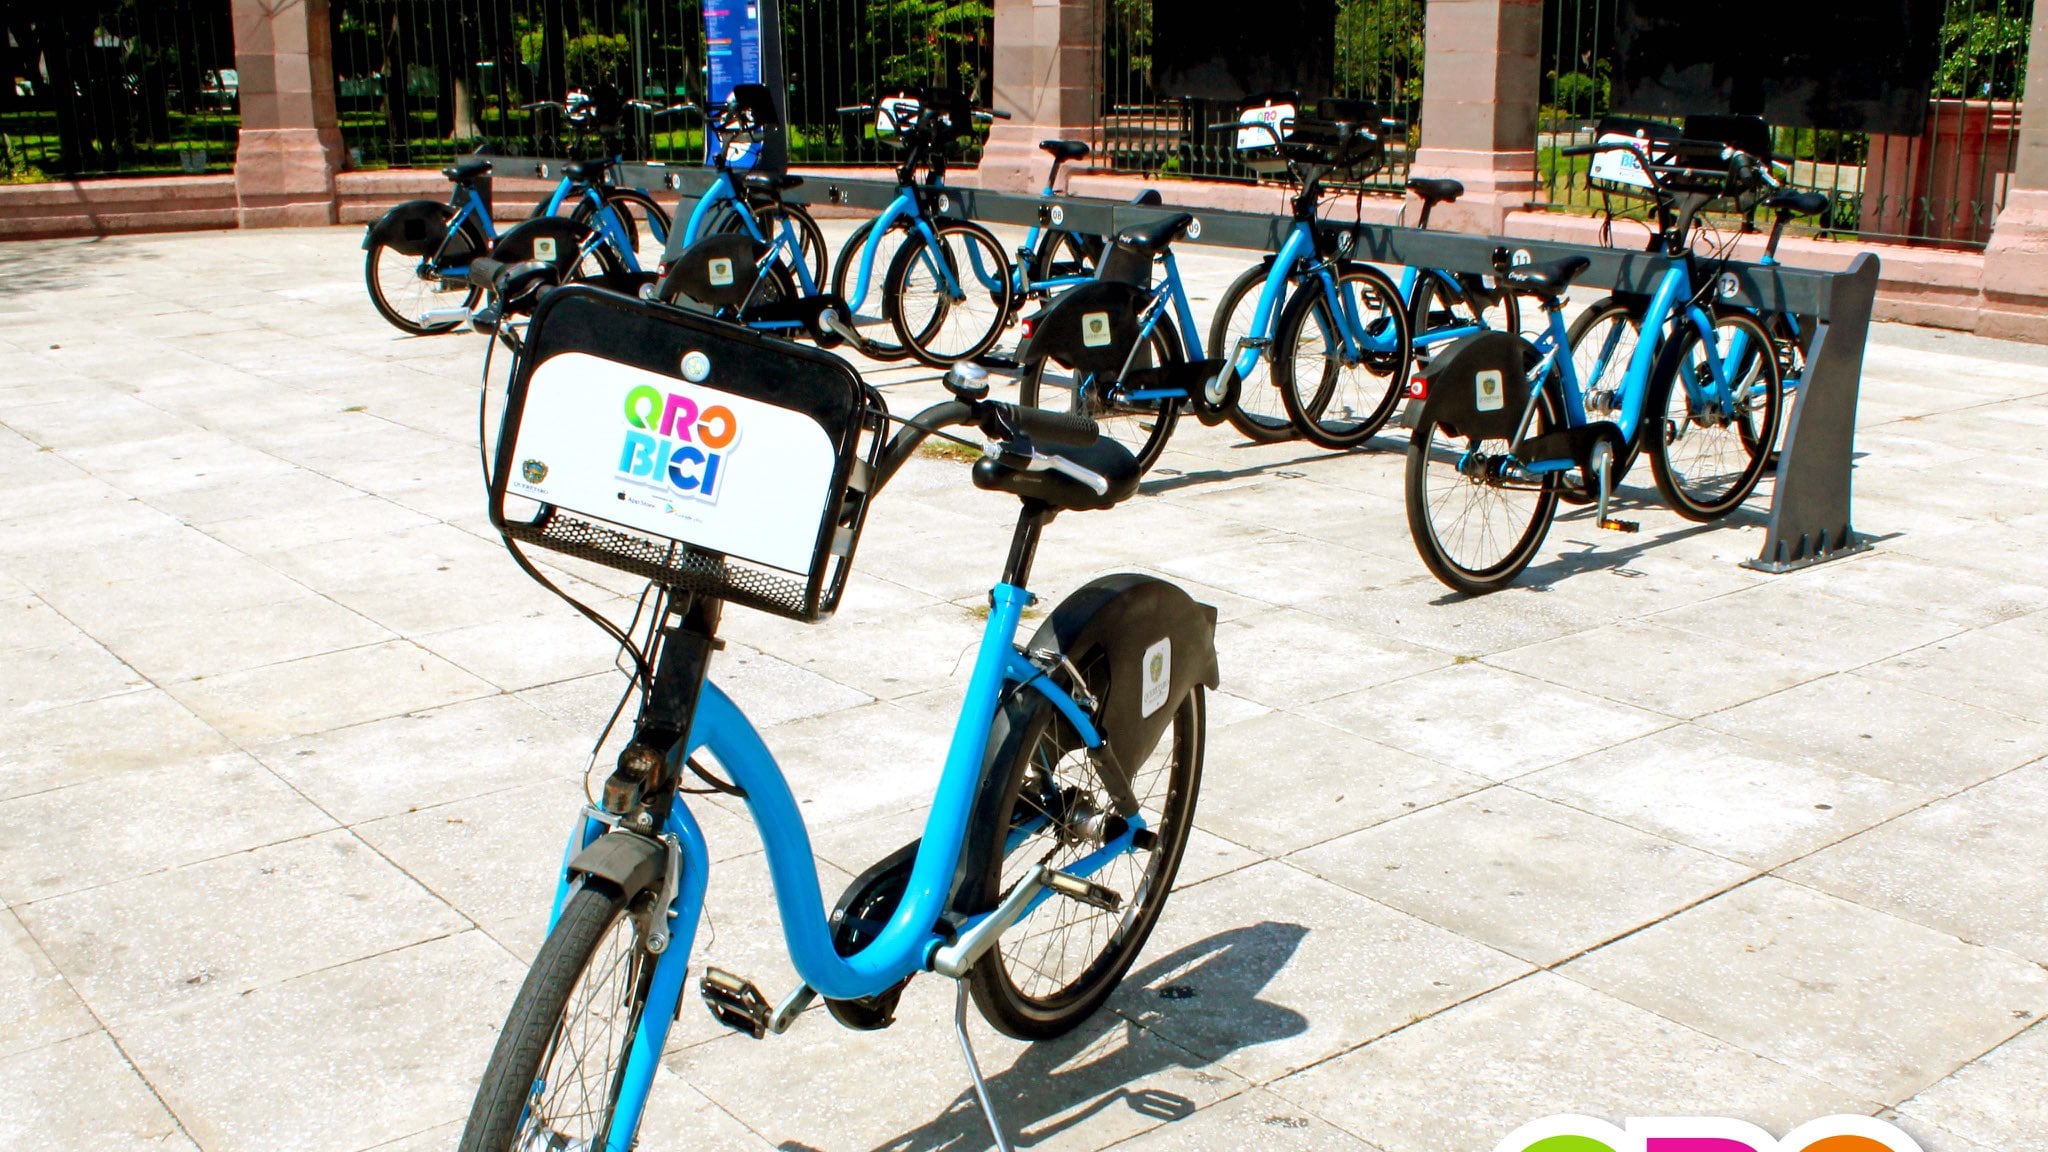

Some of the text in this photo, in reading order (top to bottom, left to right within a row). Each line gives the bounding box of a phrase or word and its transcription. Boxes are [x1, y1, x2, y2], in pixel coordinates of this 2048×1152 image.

[1721, 279, 1736, 292] 12
[624, 385, 737, 449] QRO
[619, 430, 721, 496] BICI
